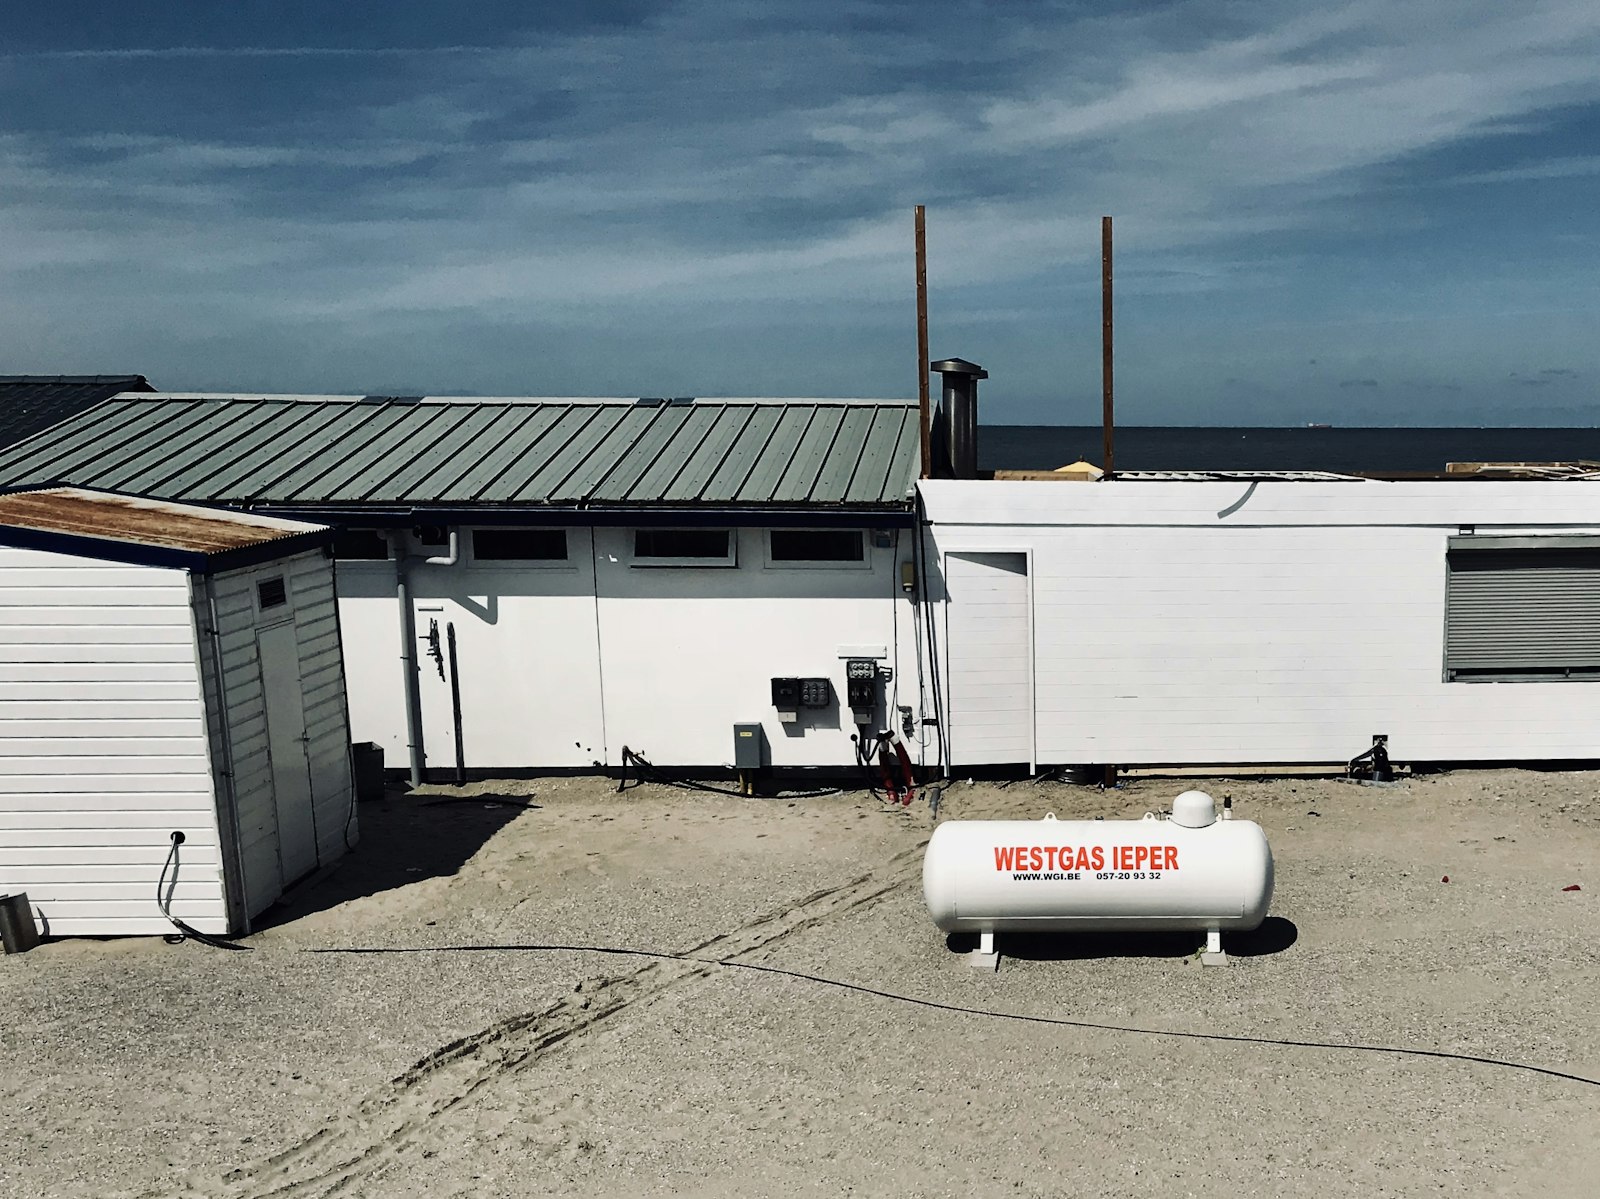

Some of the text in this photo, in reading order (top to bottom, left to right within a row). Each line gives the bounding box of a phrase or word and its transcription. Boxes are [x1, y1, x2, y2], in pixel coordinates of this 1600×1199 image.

[994, 846, 1179, 871] WESTGAS IEPER
[1012, 872, 1161, 881] WWW.WGI.BE 057-20 93 32
